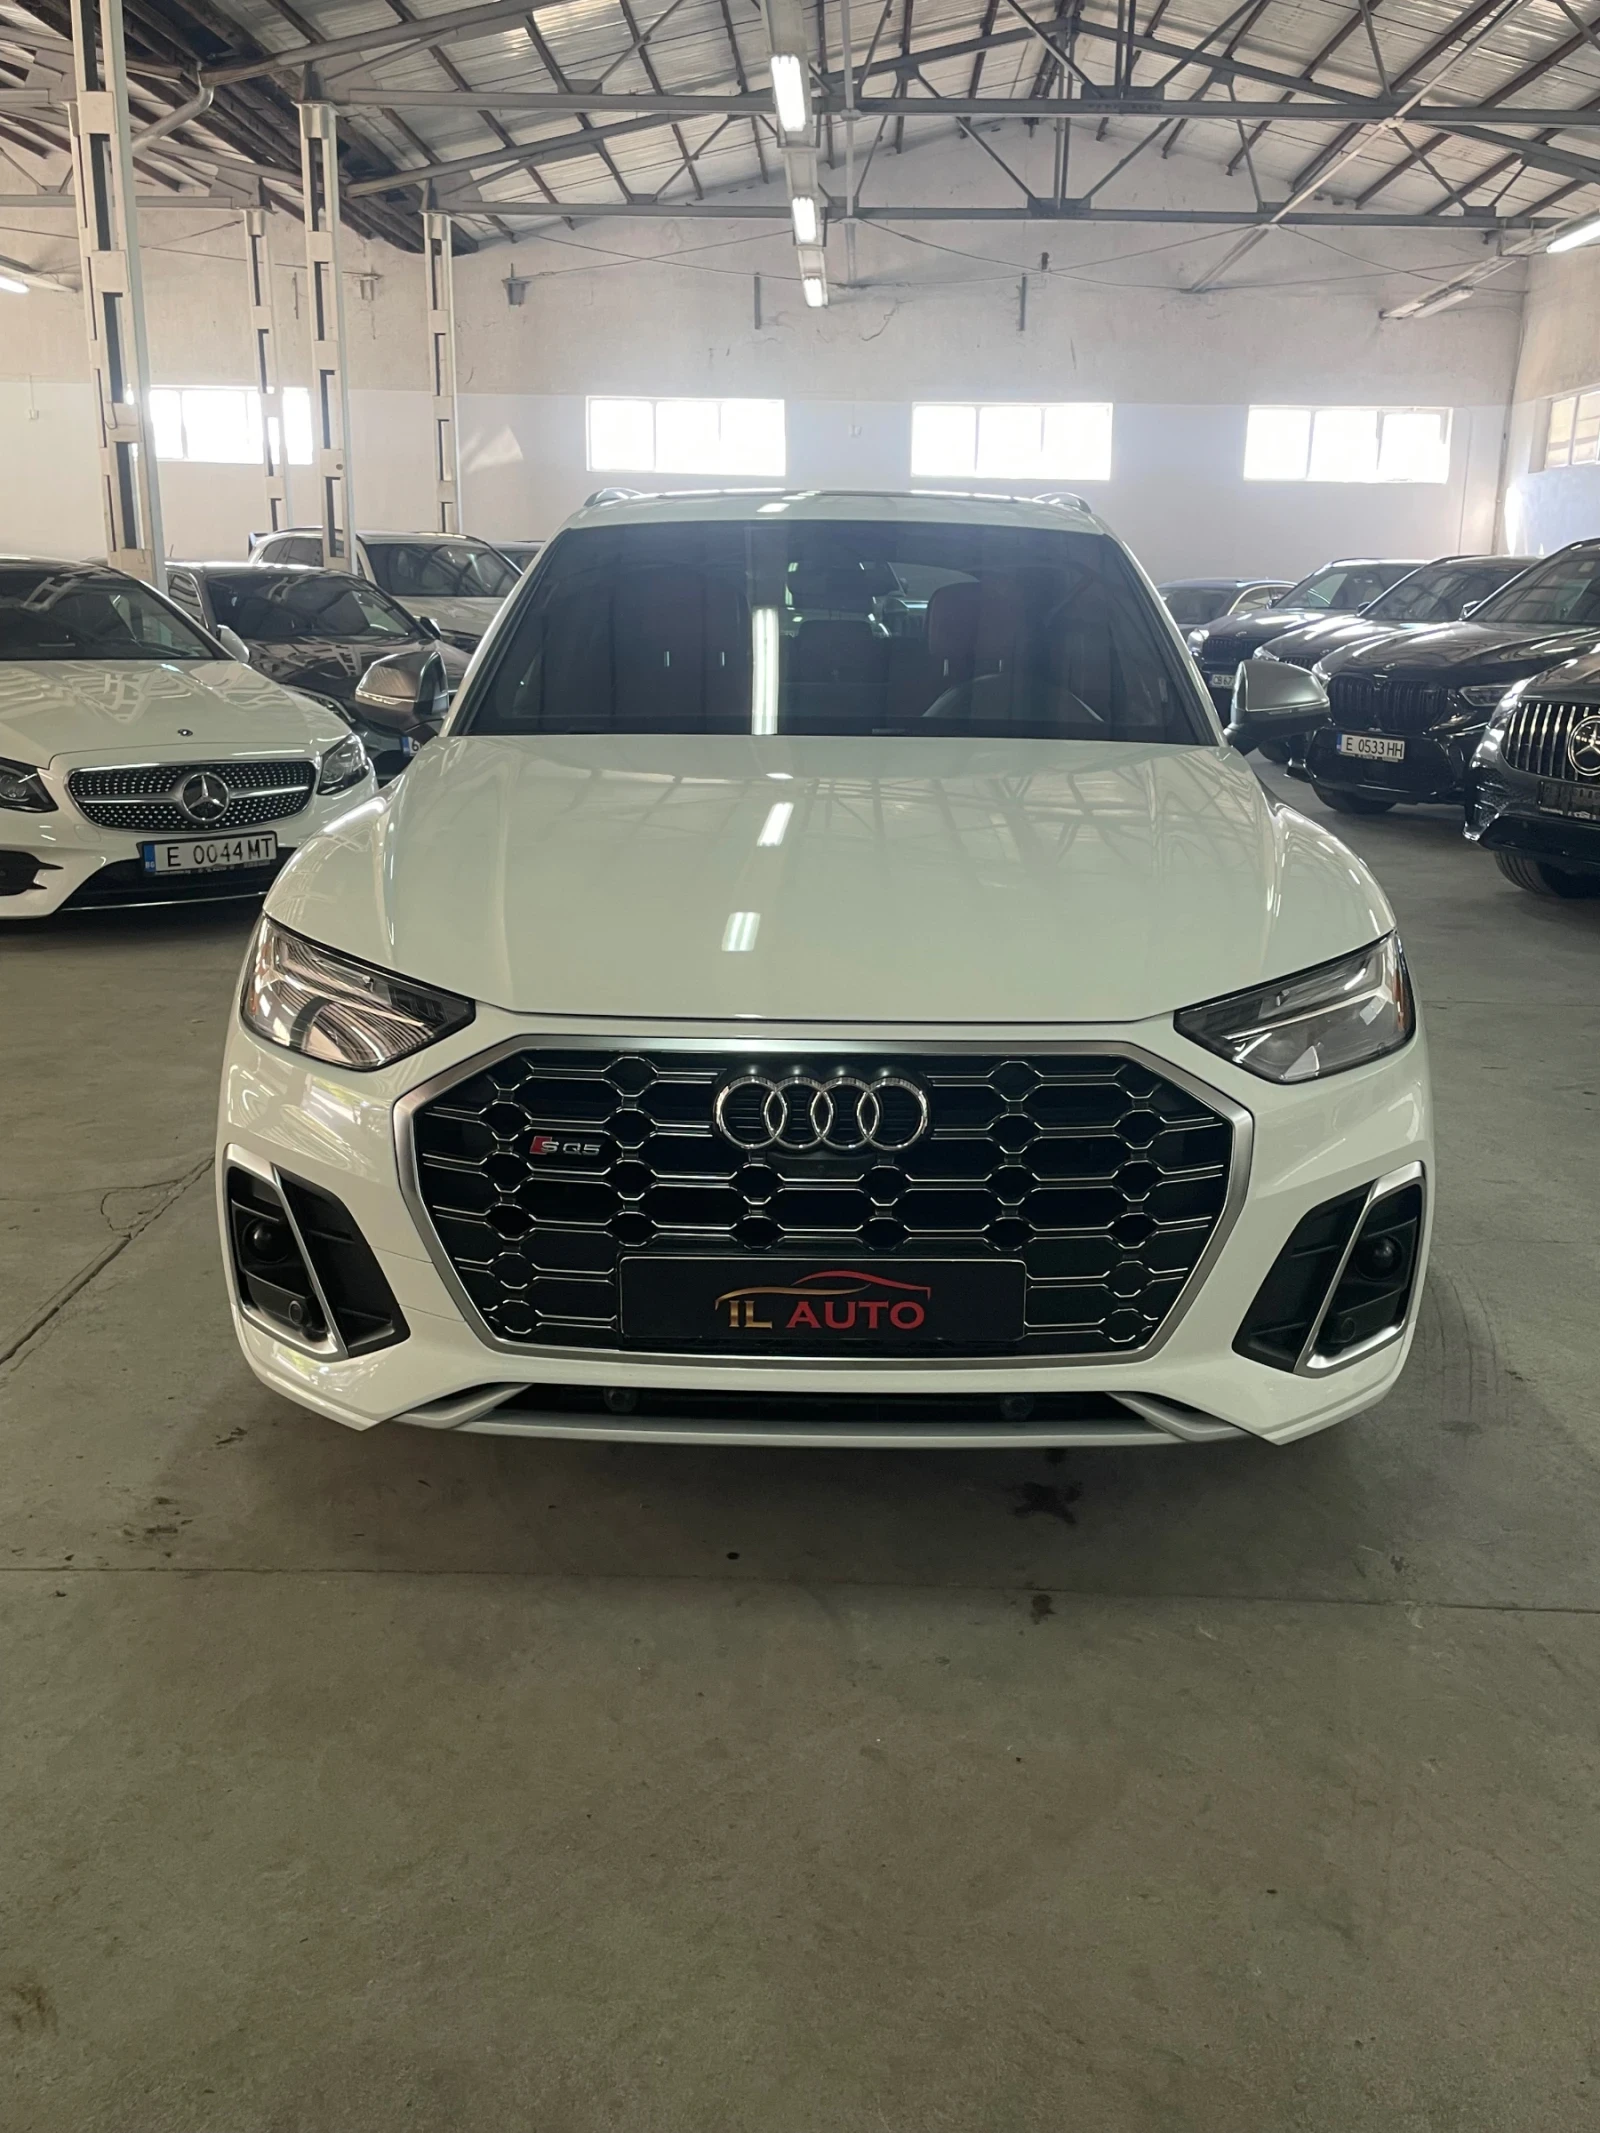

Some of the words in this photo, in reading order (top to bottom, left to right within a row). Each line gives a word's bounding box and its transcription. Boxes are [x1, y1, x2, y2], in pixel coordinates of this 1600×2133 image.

[1346, 737, 1354, 752] E
[167, 846, 182, 868] E
[541, 1141, 602, 1156] SQ5
[729, 1300, 773, 1329] IL
[785, 1300, 926, 1330] AUTO
